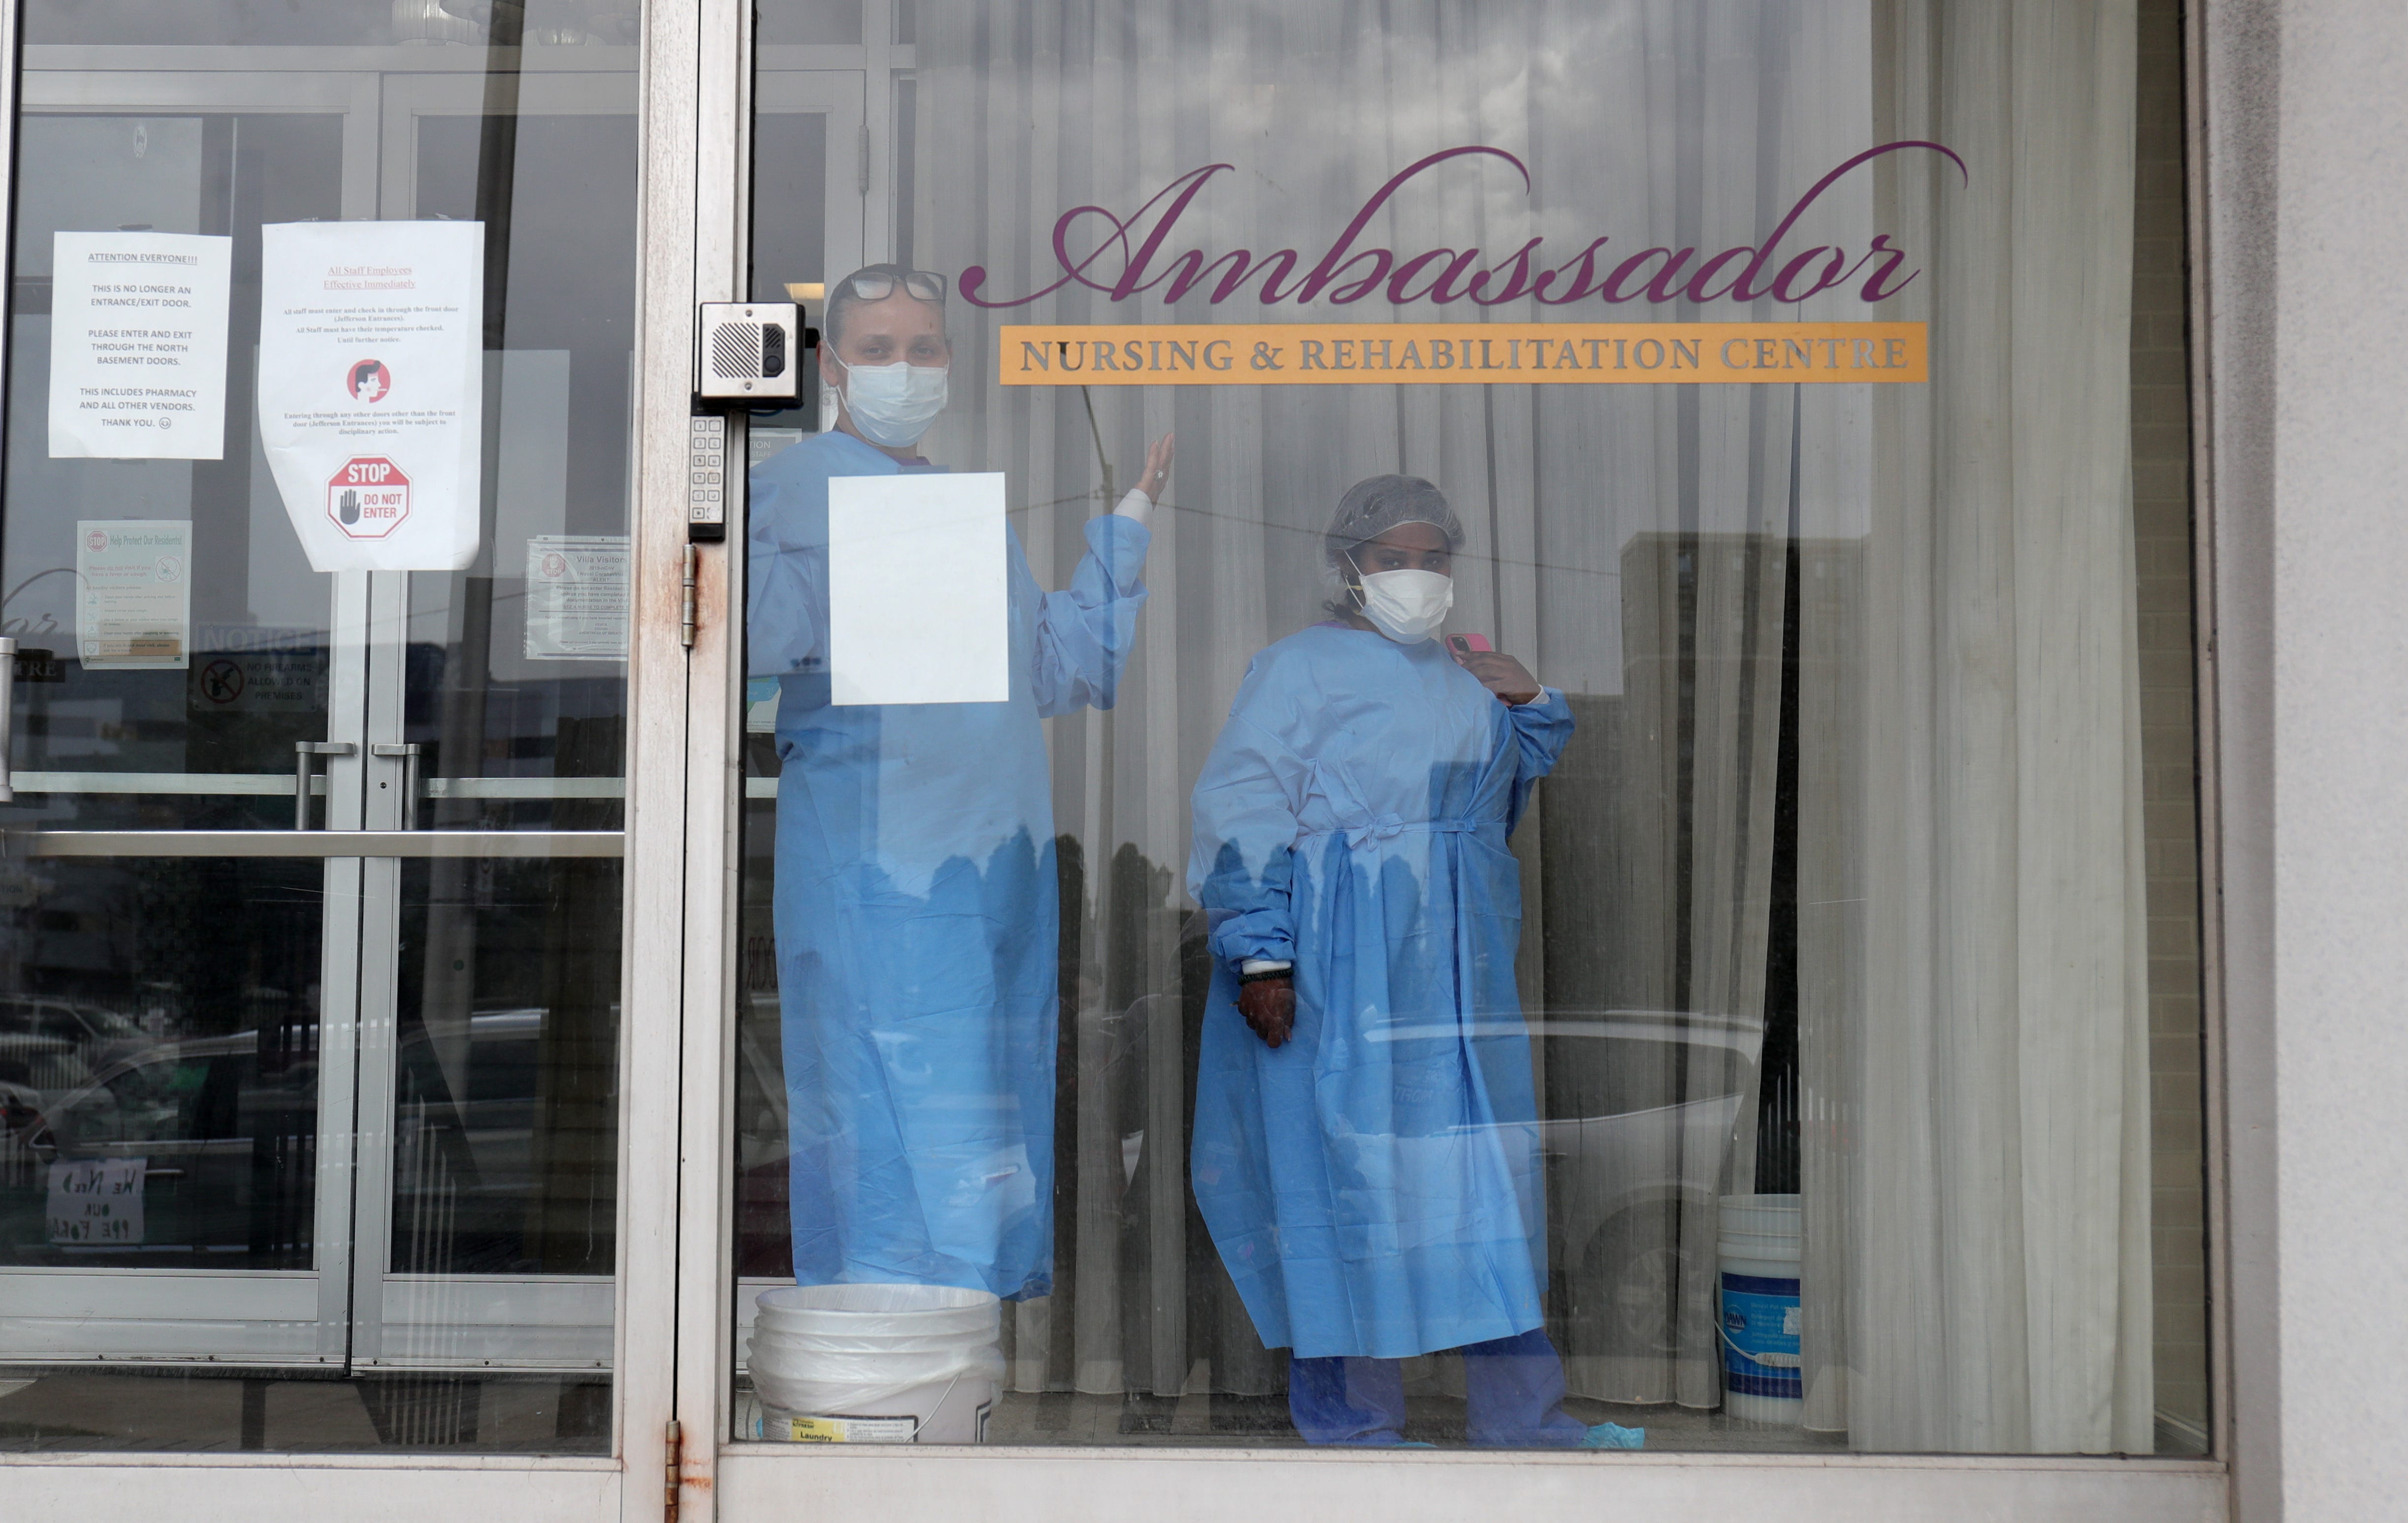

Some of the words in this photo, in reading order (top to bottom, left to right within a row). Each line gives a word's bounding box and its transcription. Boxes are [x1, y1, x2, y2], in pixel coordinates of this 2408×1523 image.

[959, 140, 1968, 308] Ambassador
[140, 254, 197, 264] EVERYONE!!!
[328, 267, 341, 275] All
[344, 266, 365, 275] Staff
[367, 266, 412, 276] Employees
[139, 285, 175, 294] LONGER
[323, 280, 362, 289] Effective
[364, 280, 416, 289] Immediately
[91, 298, 160, 307] ENTRANCE/EXIT
[162, 299, 191, 308] DOOR.
[151, 330, 170, 339] AND
[91, 343, 134, 351] THROUGH
[156, 344, 188, 352] NORTH
[1021, 340, 1233, 371] NURSING
[1249, 340, 1283, 371] &
[1299, 339, 1701, 370] REHABILITATION
[1720, 338, 1908, 369] CENTRE
[147, 357, 181, 366] DOORS.
[101, 388, 143, 397] INCLUDES
[146, 389, 196, 398] PHARMACY
[118, 402, 147, 410] OTHER
[150, 403, 195, 411] VENDORS.
[348, 464, 390, 482] STOP
[364, 494, 379, 505] DO
[381, 494, 402, 505] NOT
[363, 507, 396, 518] ENTER
[89, 537, 106, 546] STOP
[110, 535, 122, 547] Help
[123, 535, 142, 546] Protect
[143, 535, 153, 545] Our
[155, 535, 182, 546] Residents!
[14, 660, 56, 676] TRE
[247, 663, 261, 672] NO
[264, 663, 312, 672] FIREARMS
[248, 678, 293, 686] ALLOWED
[255, 692, 302, 700] PREMISES
[1725, 1312, 1746, 1325] DAWN
[800, 1431, 832, 1442] Laundry
